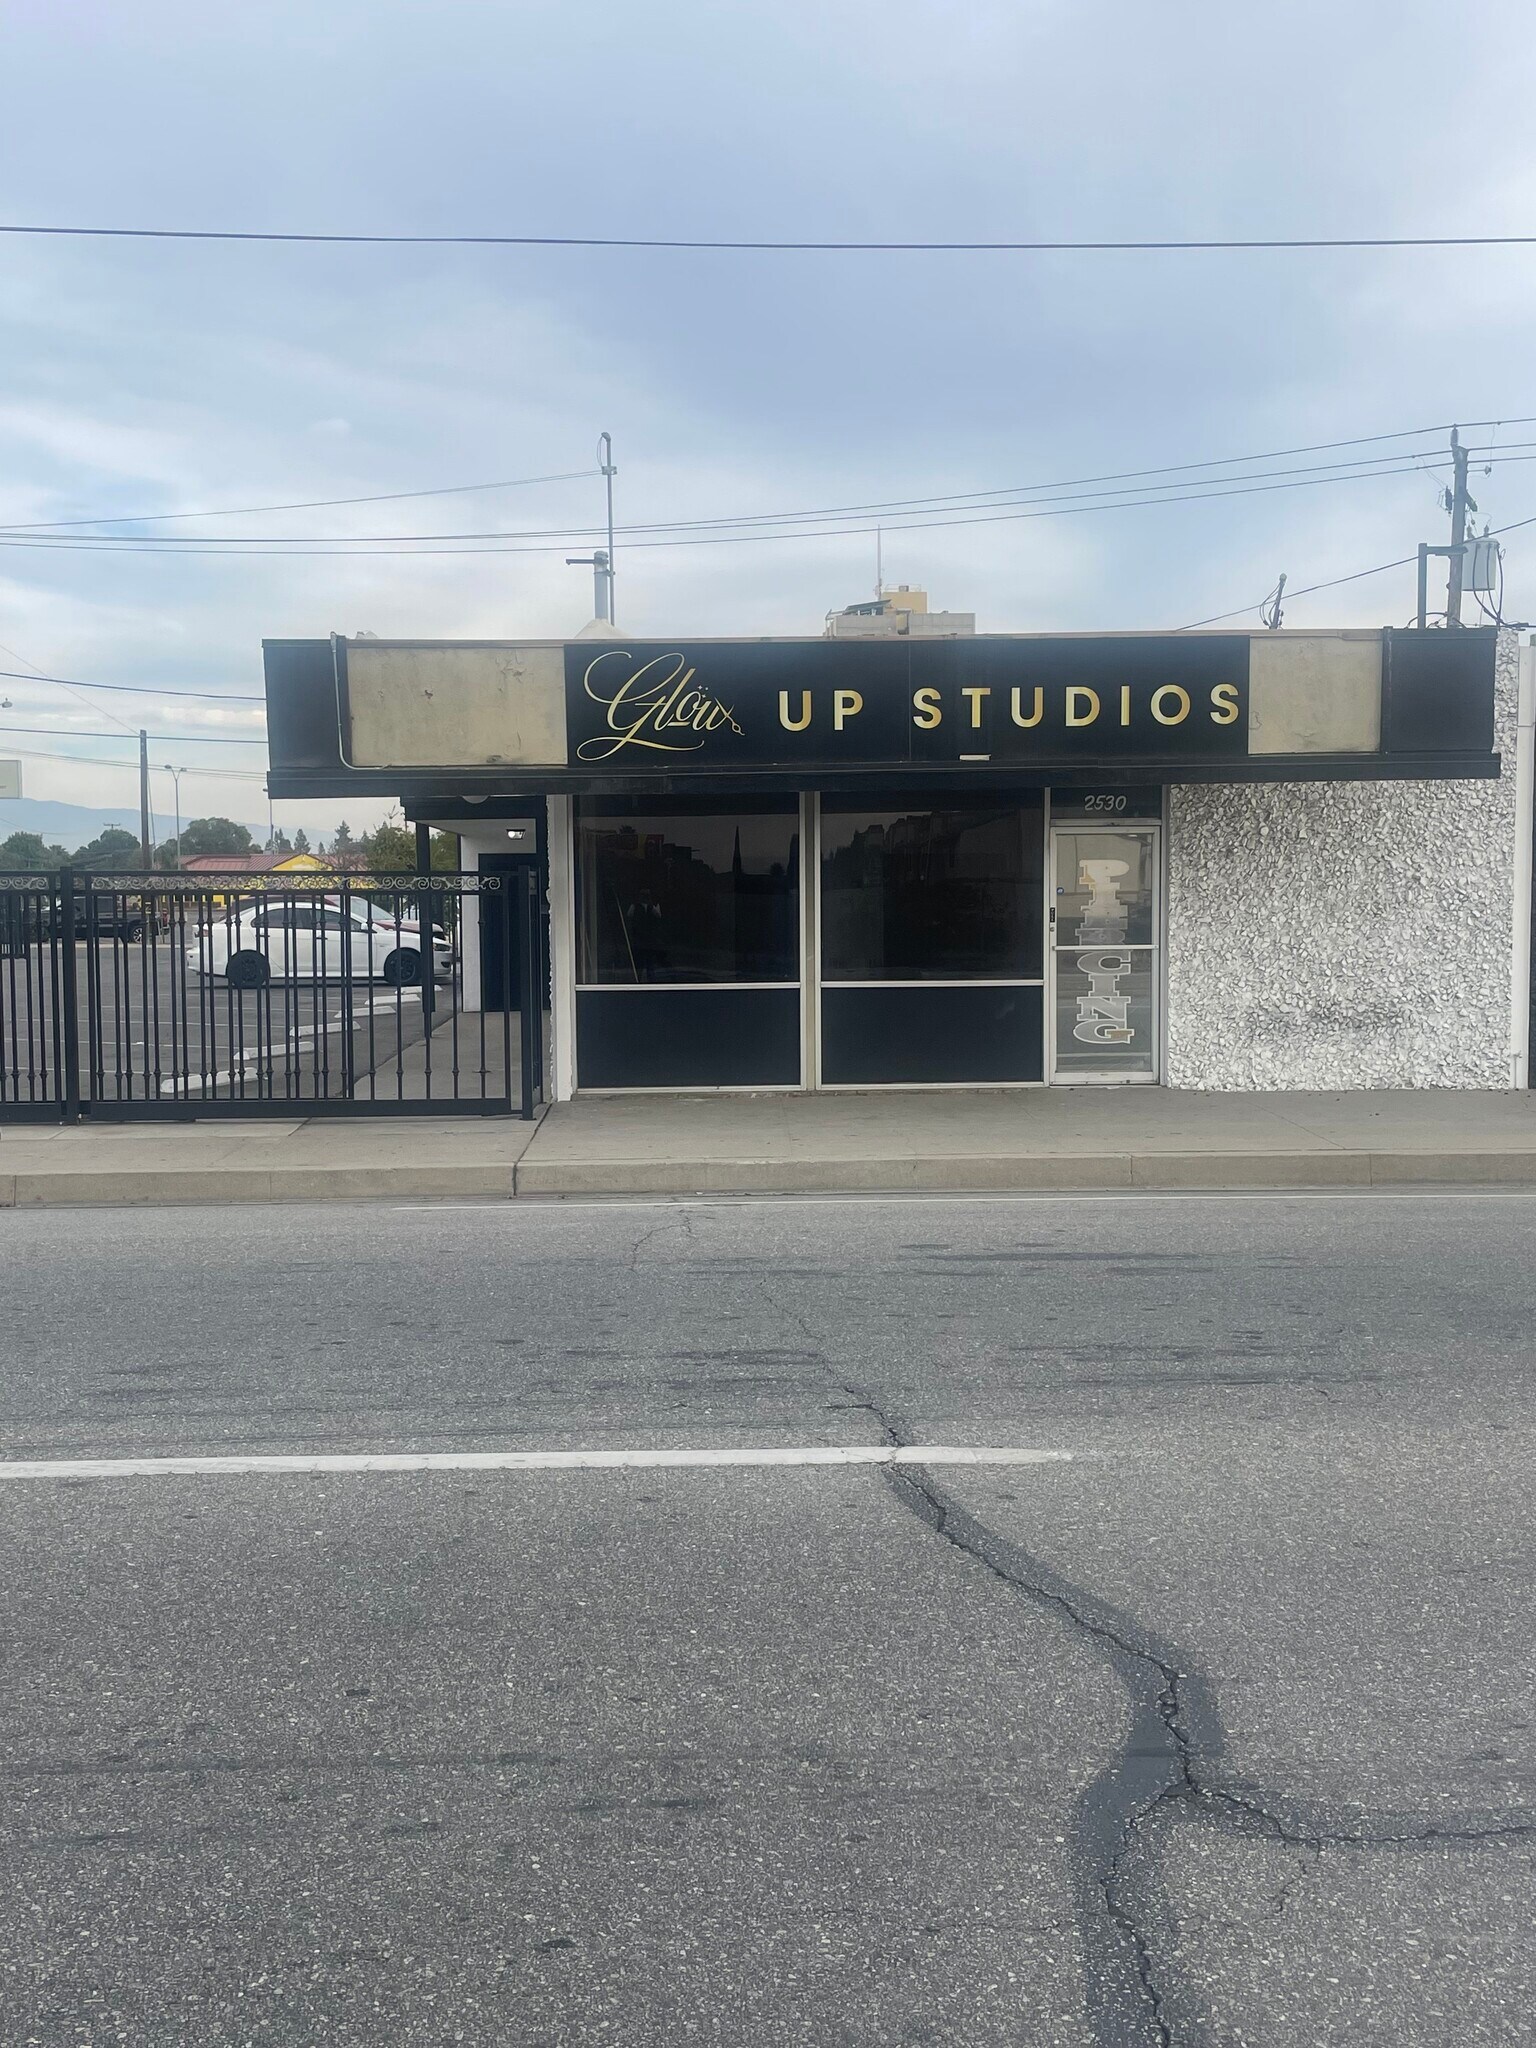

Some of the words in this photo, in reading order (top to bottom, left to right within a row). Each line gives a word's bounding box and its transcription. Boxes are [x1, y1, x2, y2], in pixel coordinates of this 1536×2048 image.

[778, 690, 864, 731] UP
[912, 684, 1240, 729] STUDIOS
[1084, 795, 1127, 811] 2530
